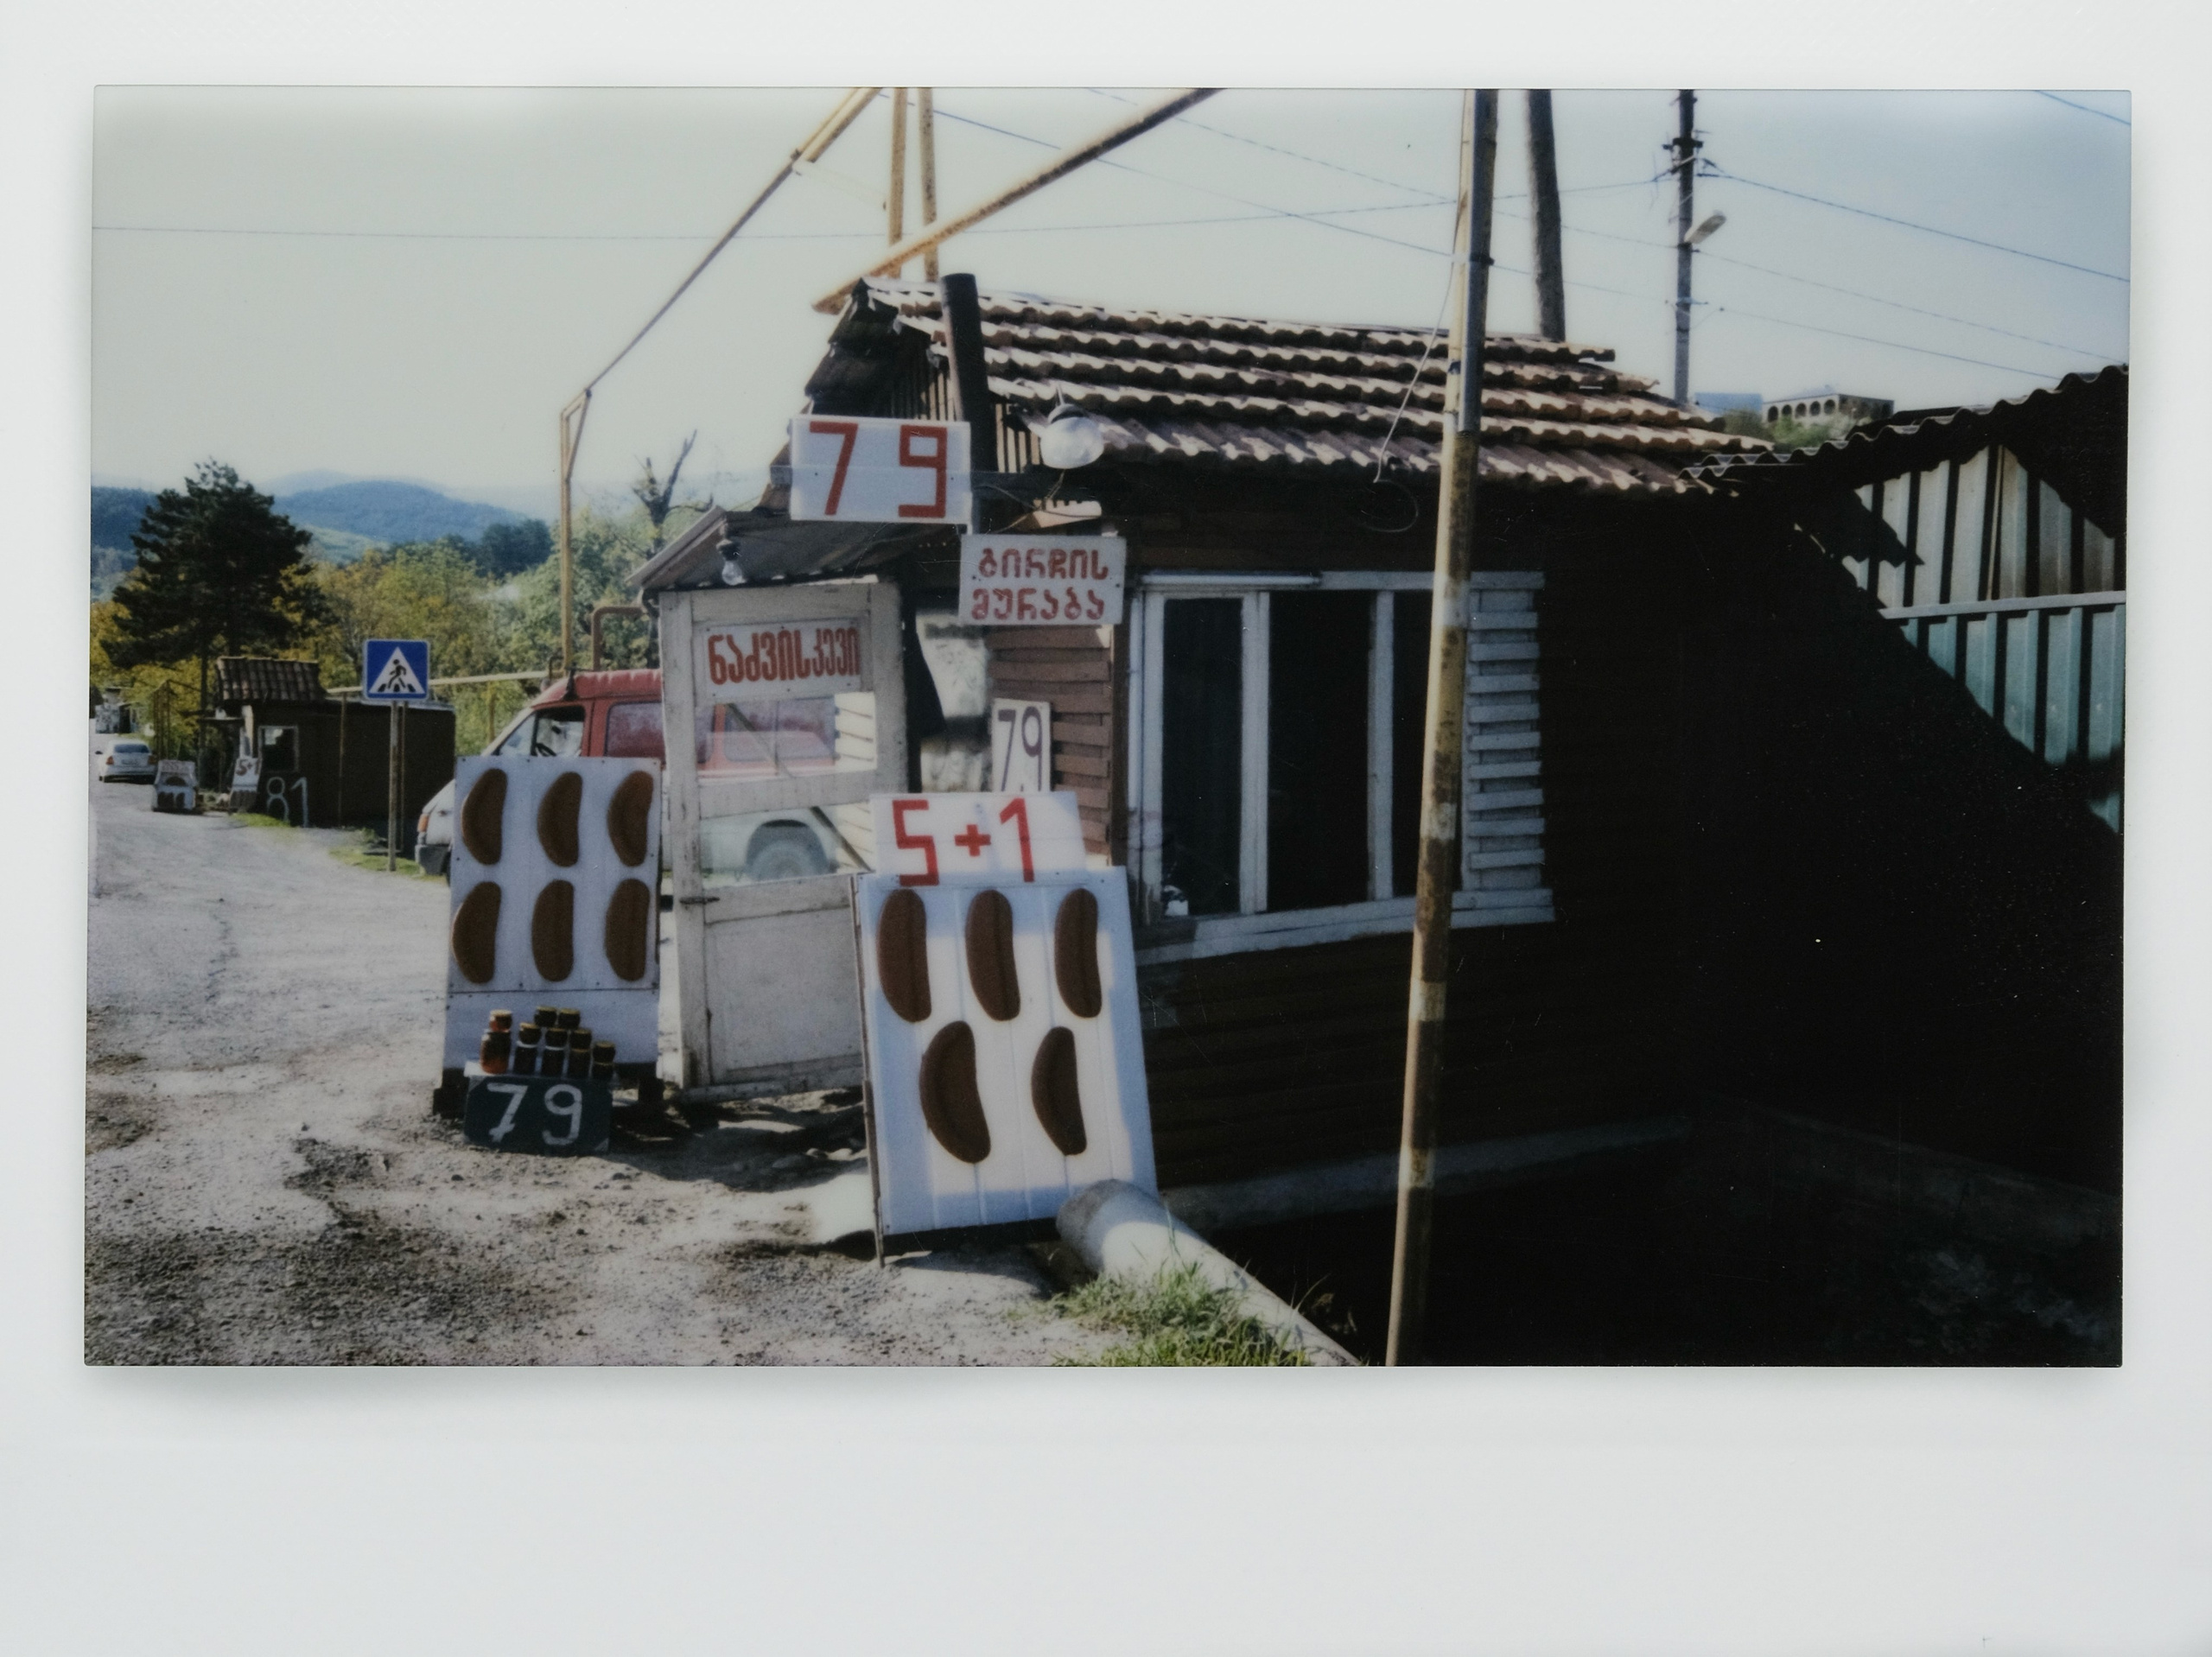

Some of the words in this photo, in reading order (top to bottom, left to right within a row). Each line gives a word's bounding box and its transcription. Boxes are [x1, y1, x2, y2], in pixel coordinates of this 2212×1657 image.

[810, 421, 948, 518] 79
[971, 587, 1104, 620] მურაბა
[998, 706, 1042, 791] 79
[266, 778, 308, 828] 81
[892, 797, 1035, 886] 5+1
[487, 1082, 582, 1146] 79
